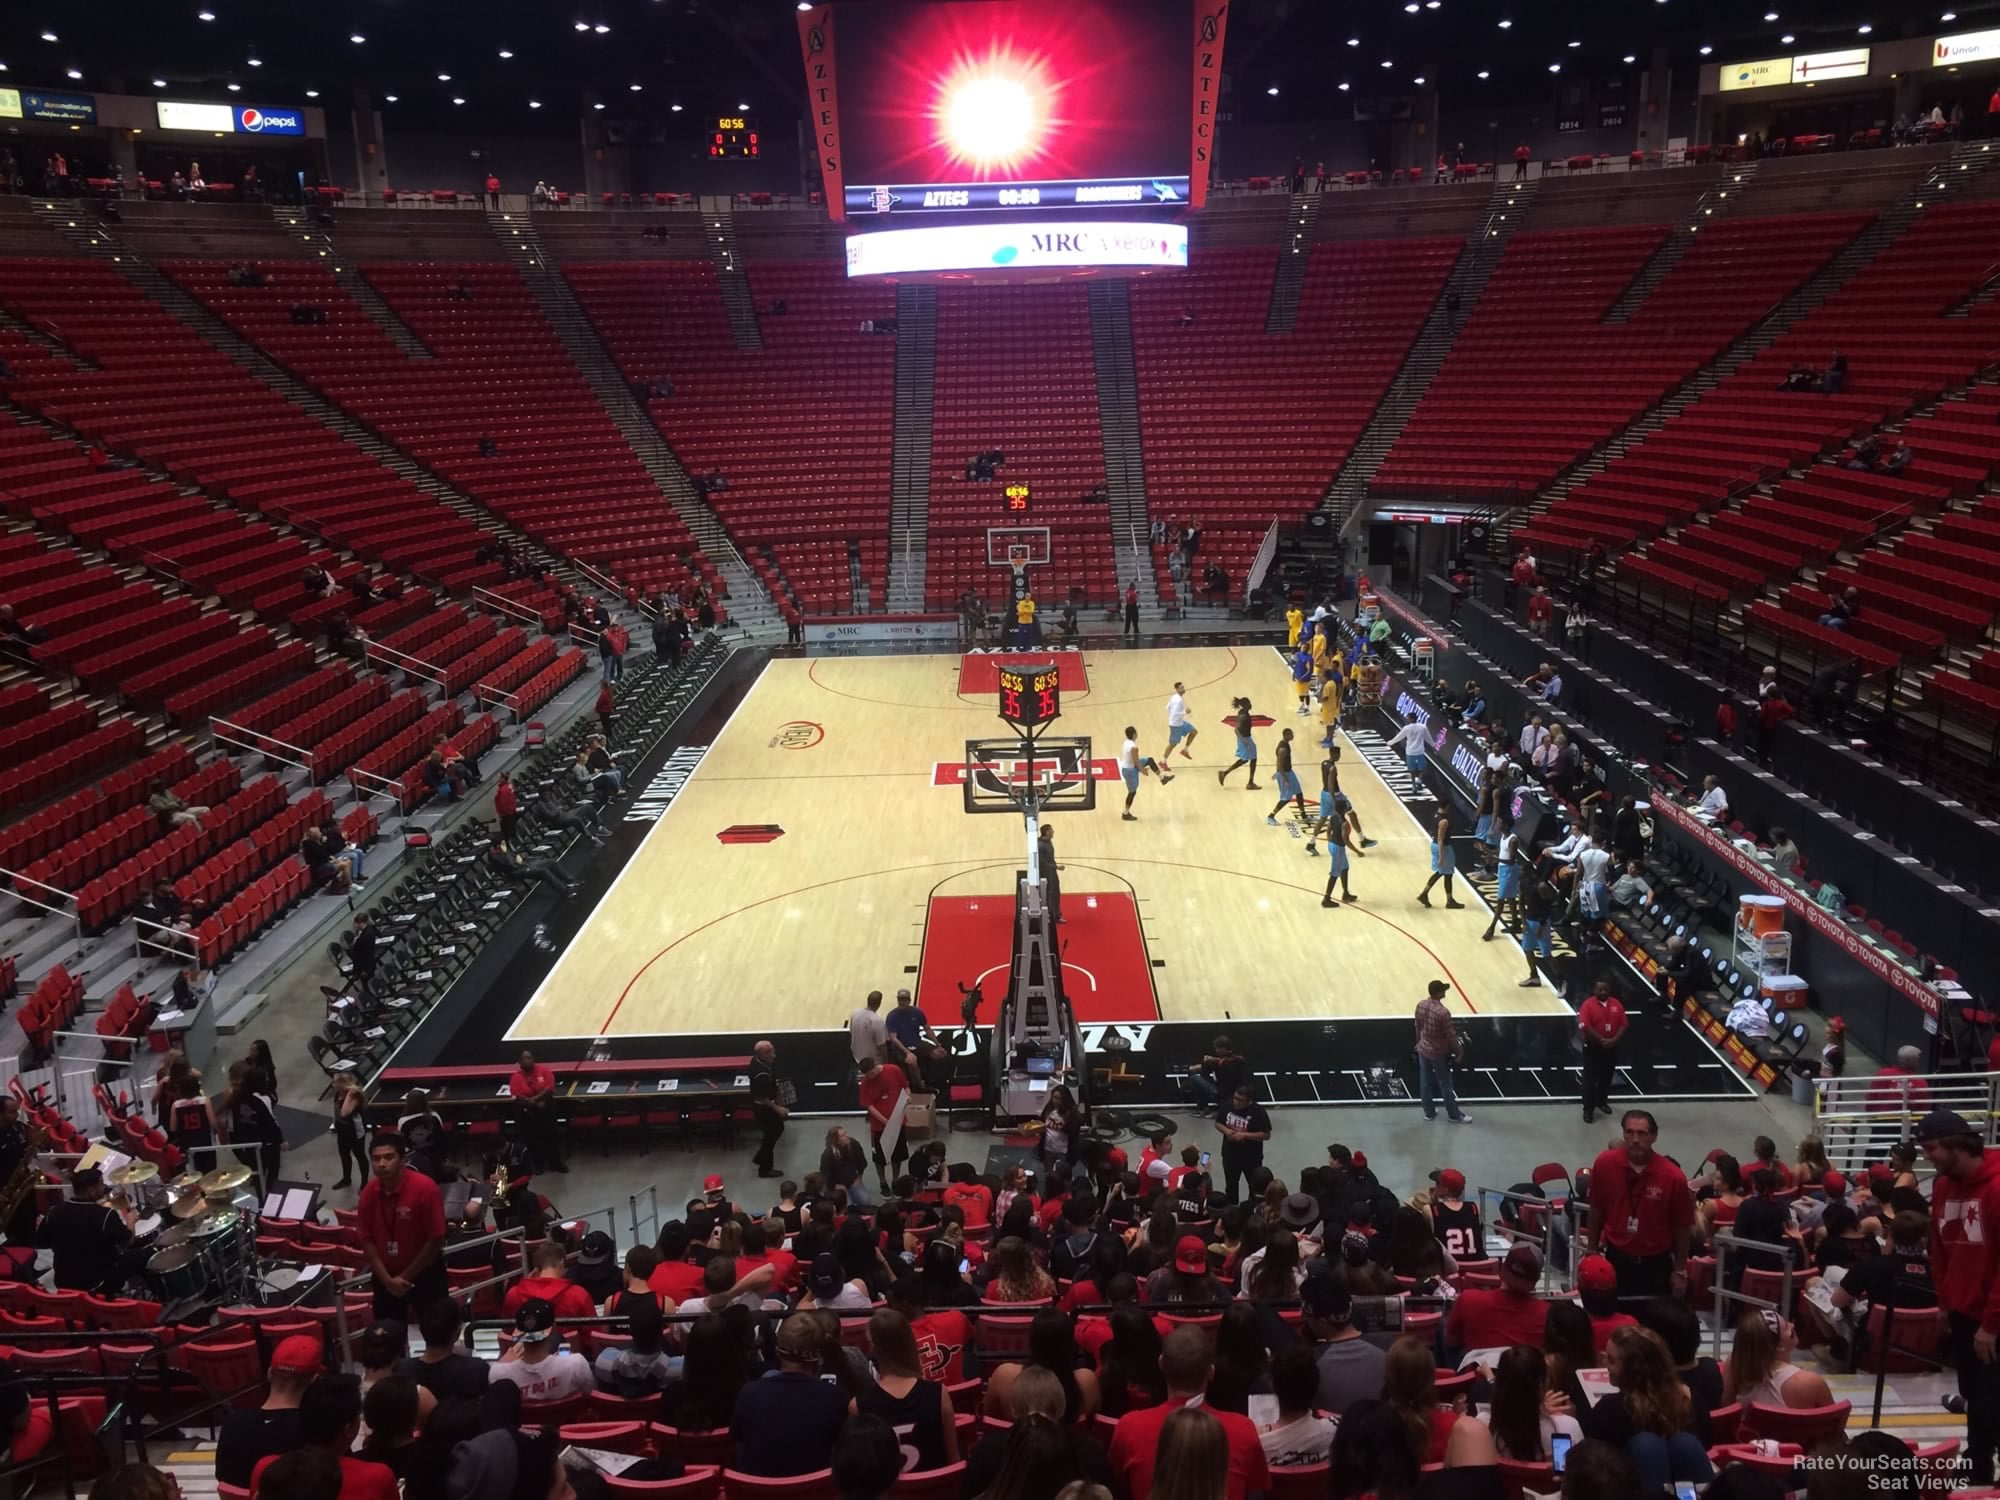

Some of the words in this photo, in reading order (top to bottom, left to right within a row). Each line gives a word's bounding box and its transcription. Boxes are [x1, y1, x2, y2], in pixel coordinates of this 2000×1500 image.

[264, 115, 296, 128] pepsi
[923, 190, 969, 207] AZTECS
[1032, 233, 1088, 253] MRC
[1010, 496, 1026, 509] 35
[838, 626, 860, 636] MRC
[890, 626, 914, 636] xerox
[1005, 689, 1021, 718] 35
[1039, 689, 1054, 718] 35
[662, 745, 709, 771] STATE
[638, 770, 689, 800] DIEGO
[622, 801, 668, 822] SAN
[1658, 797, 1677, 819] TOYOTA
[1685, 816, 1705, 840] TOYOTA
[1714, 836, 1736, 861] TOYOTA
[1745, 860, 1769, 886] TOYOTA
[1778, 885, 1805, 914] TOYOTA
[1816, 912, 1846, 943] TOYOTA
[1857, 943, 1888, 977] TOYOTA
[1903, 975, 1939, 1014] TOYOTA
[1225, 1111, 1250, 1129] SWEET
[1446, 1227, 1477, 1255] 21
